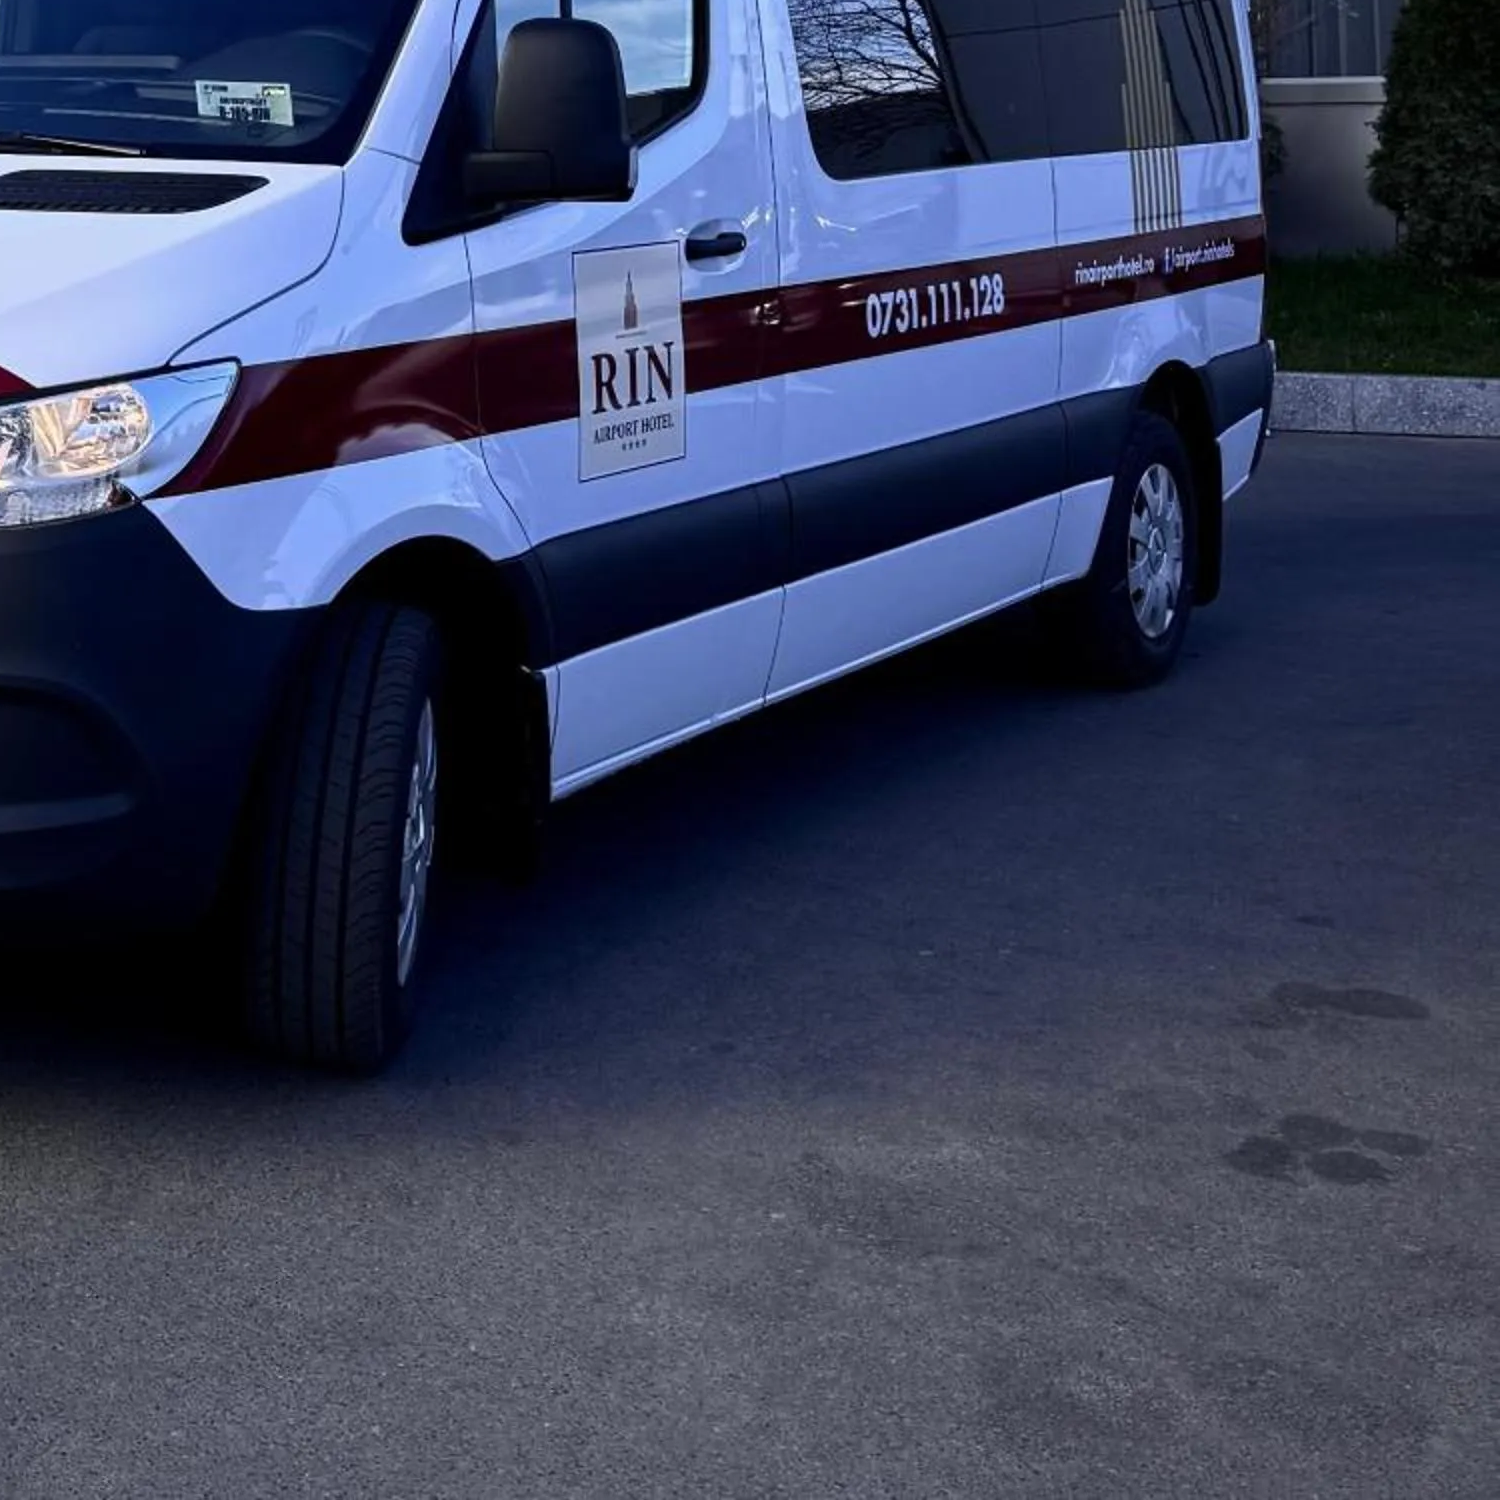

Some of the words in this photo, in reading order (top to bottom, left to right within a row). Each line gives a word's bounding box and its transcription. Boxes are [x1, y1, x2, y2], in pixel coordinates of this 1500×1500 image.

[866, 273, 1004, 338] 0731.111.128
[591, 341, 674, 414] RIN
[593, 419, 638, 445] AIRPORT
[641, 414, 674, 435] HOTEL
